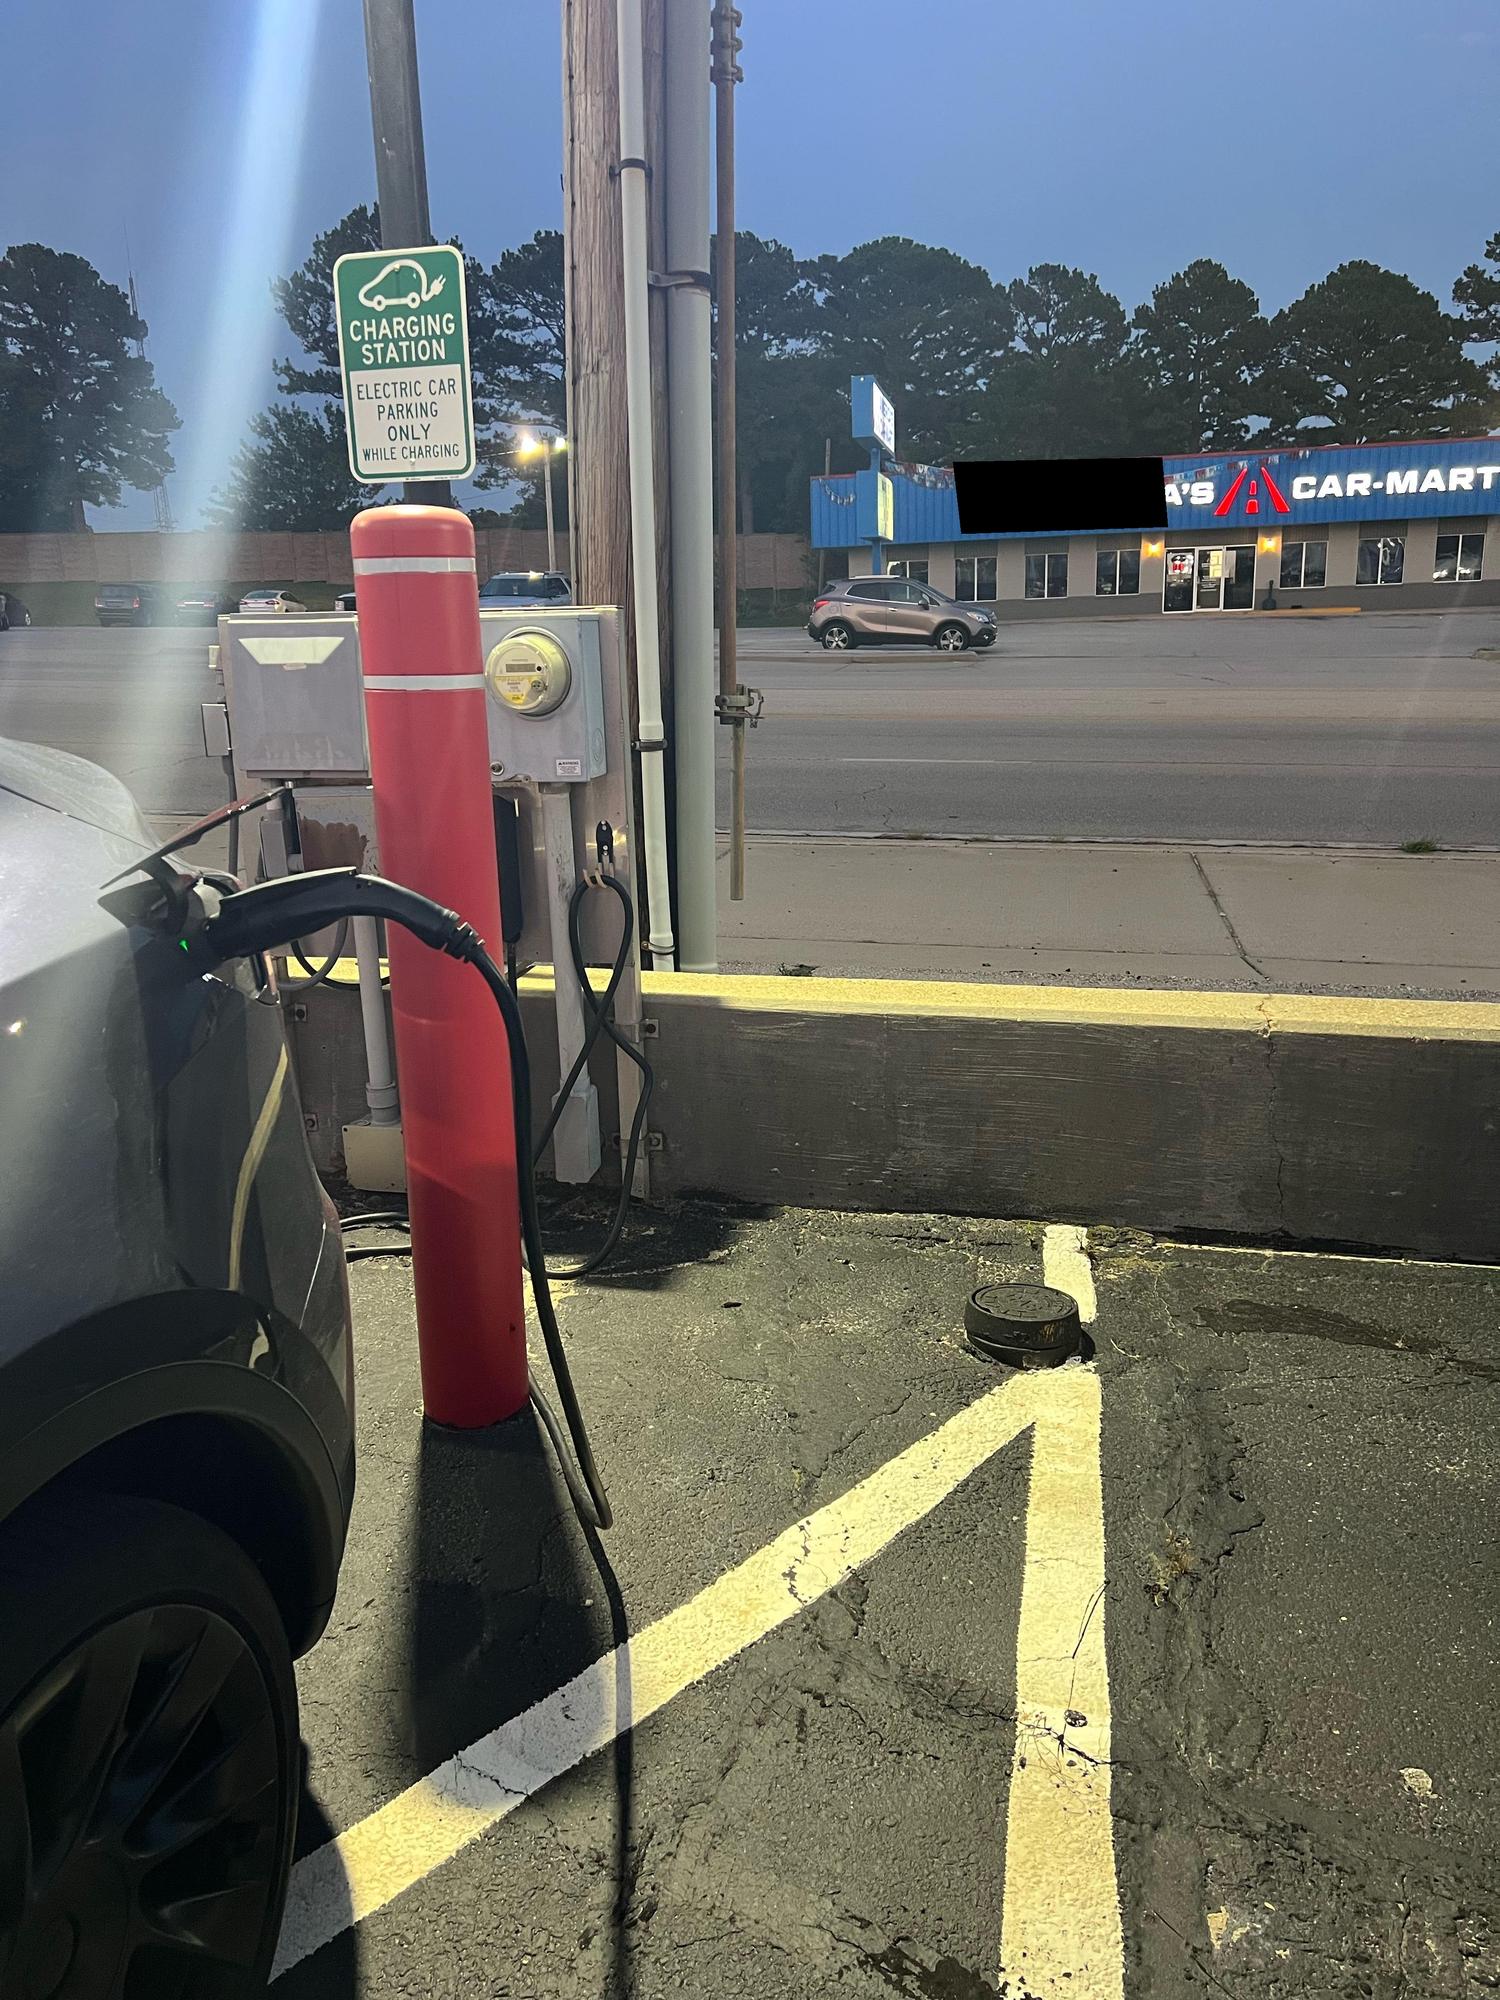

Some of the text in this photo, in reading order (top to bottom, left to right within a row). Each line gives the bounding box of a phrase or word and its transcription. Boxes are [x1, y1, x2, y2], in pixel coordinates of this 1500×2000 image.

[349, 313, 455, 342] CHARGING
[361, 338, 446, 365] STATION
[356, 378, 456, 400] ELECTRIC CAR
[377, 401, 438, 421] PARKING
[387, 423, 431, 441] ONLY
[362, 443, 460, 462] WHILE CHARGING
[1292, 466, 1500, 500] CAR-MART
